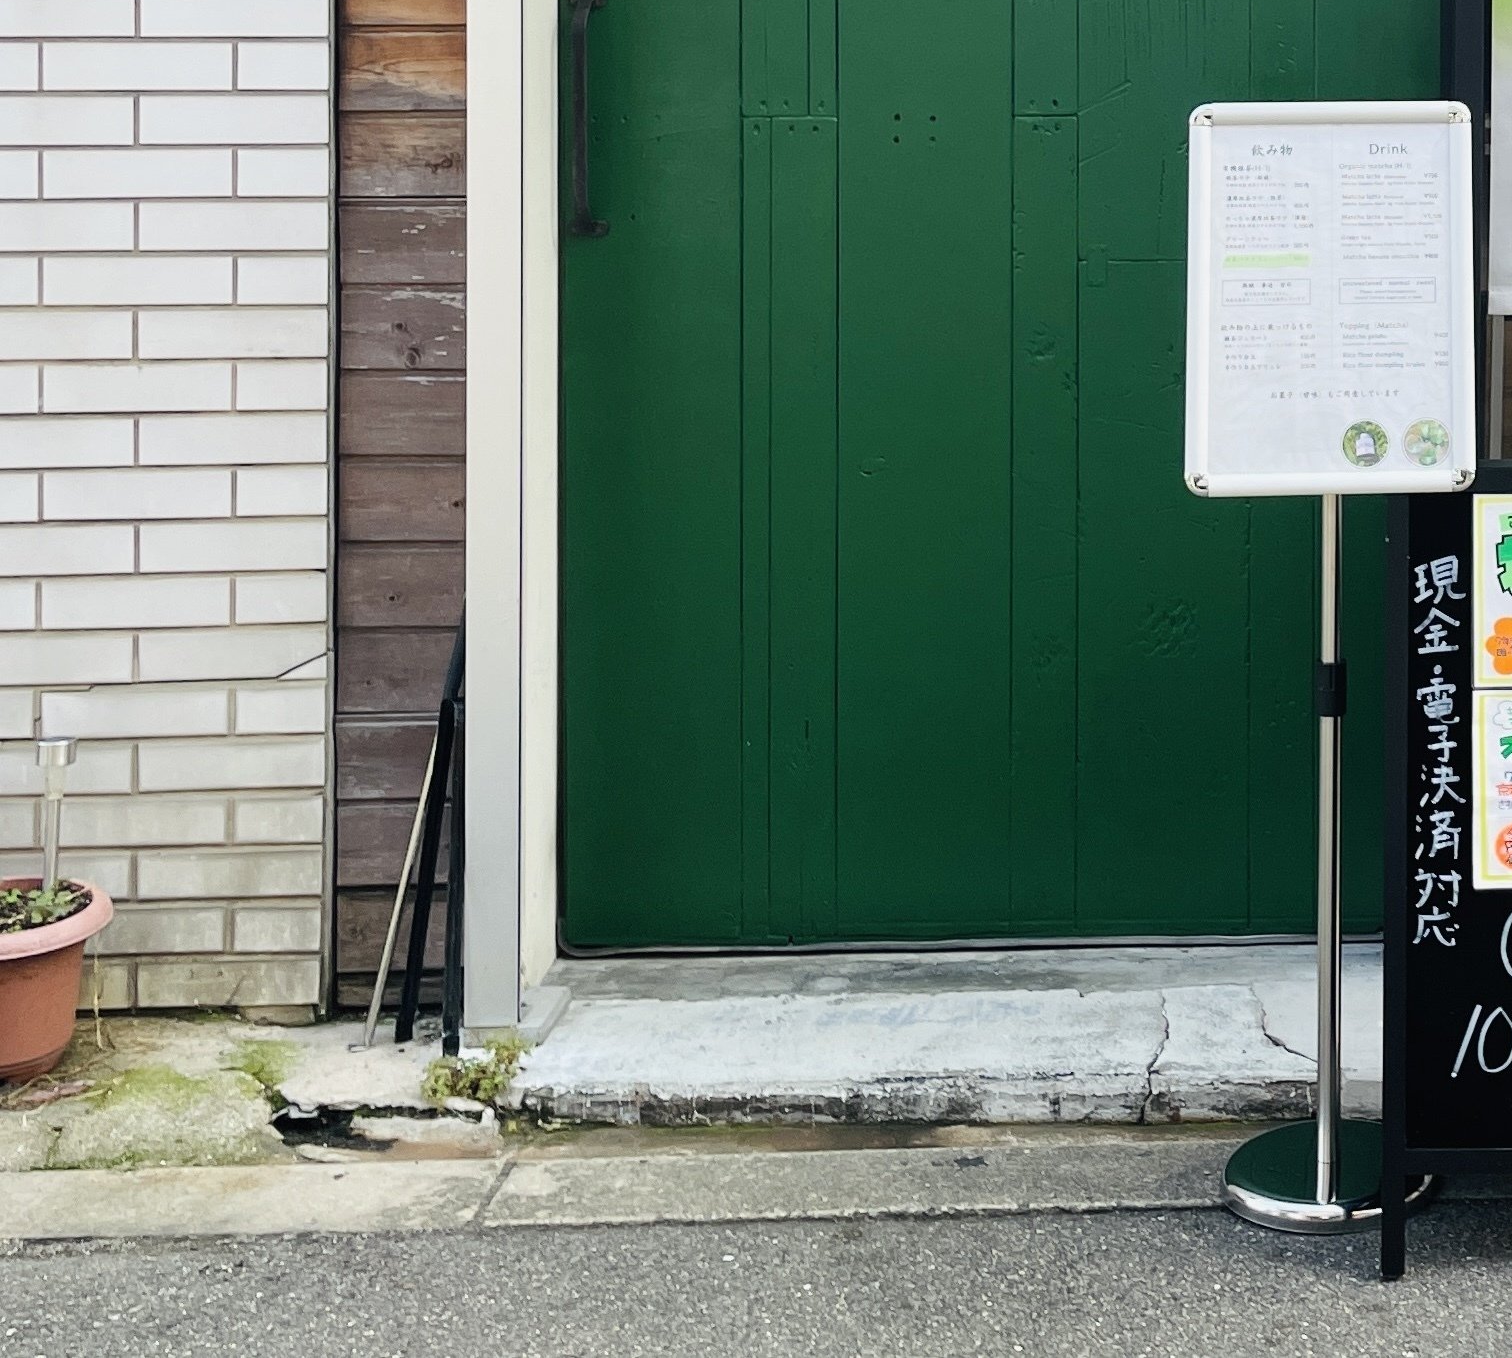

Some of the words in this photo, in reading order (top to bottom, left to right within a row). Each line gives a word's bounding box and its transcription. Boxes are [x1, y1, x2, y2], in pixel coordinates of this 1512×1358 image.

[1251, 143, 1294, 157] 飲み物
[1368, 142, 1409, 156] Drink
[1411, 553, 1467, 948] 現金・電子決済対応
